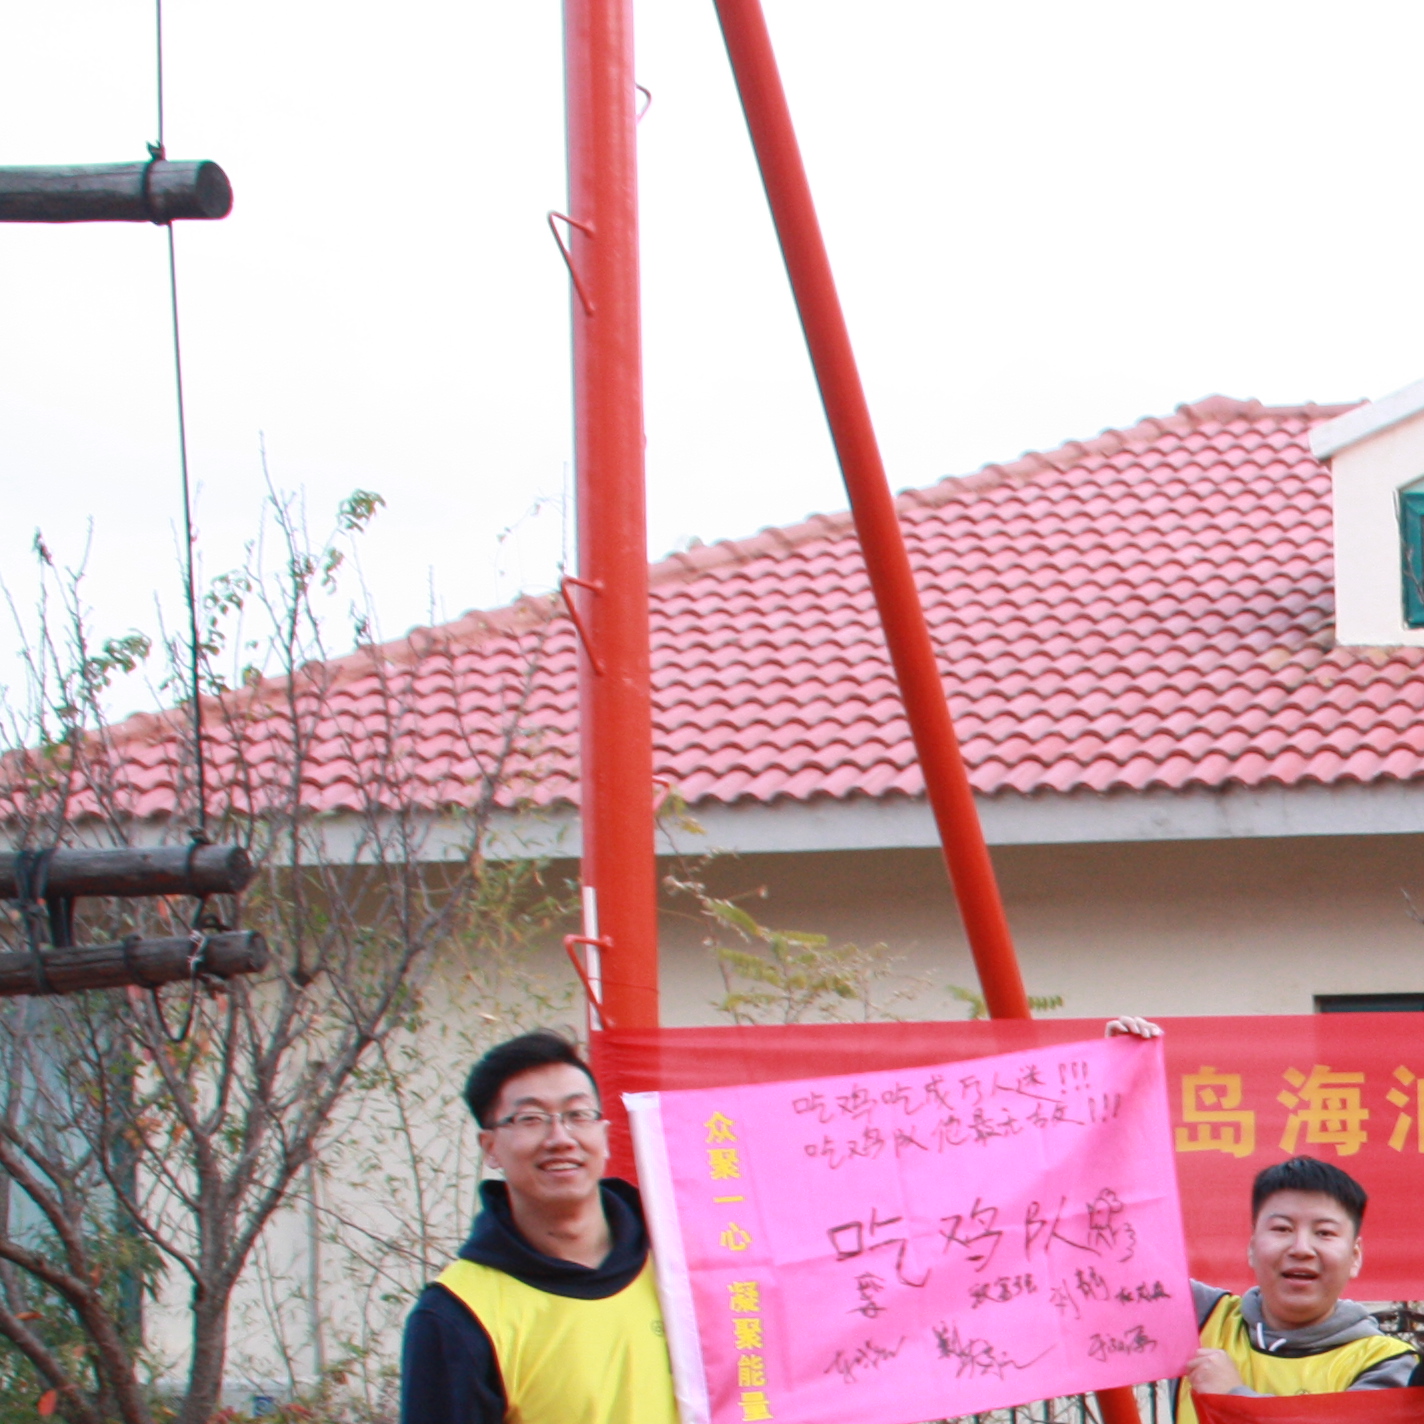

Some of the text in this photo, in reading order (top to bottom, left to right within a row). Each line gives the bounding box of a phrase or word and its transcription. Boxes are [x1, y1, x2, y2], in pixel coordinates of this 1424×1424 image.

[703, 1110, 774, 1423] 众聚一心 凝聚能量
[827, 1195, 1090, 1290] 吃鸡队
